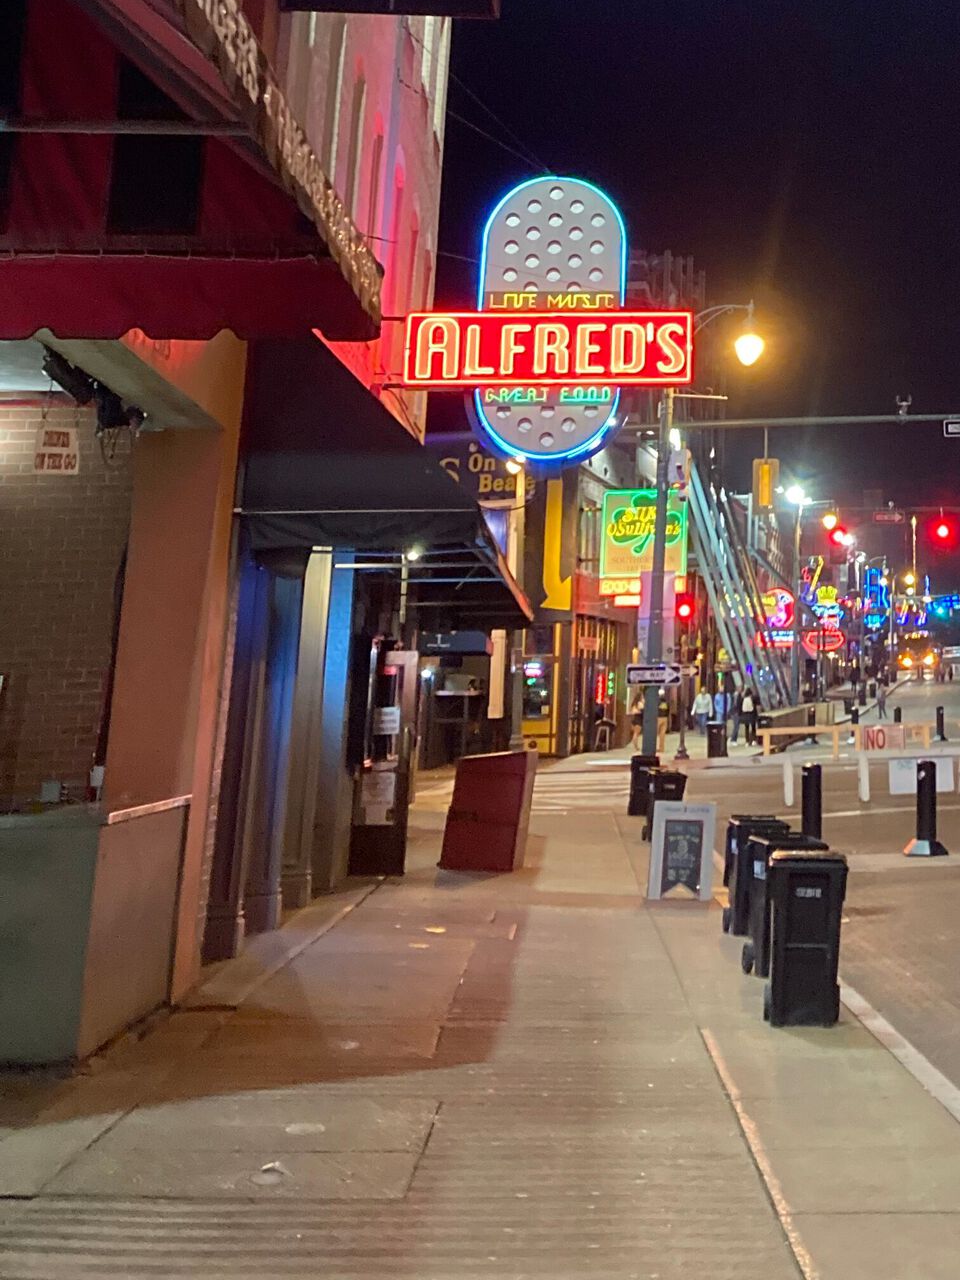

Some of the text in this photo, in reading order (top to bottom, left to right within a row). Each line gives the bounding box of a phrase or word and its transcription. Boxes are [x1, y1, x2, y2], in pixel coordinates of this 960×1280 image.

[489, 293, 615, 309] LIVE MUSIC
[414, 317, 686, 380] ALFRED'S
[484, 386, 612, 402] GREAT FOOD
[64, 453, 77, 470] GO
[468, 453, 496, 472] On
[479, 474, 536, 493] Beae
[622, 504, 669, 523] SILK
[607, 519, 681, 536] O'Sullivn's
[866, 728, 886, 750] NO
